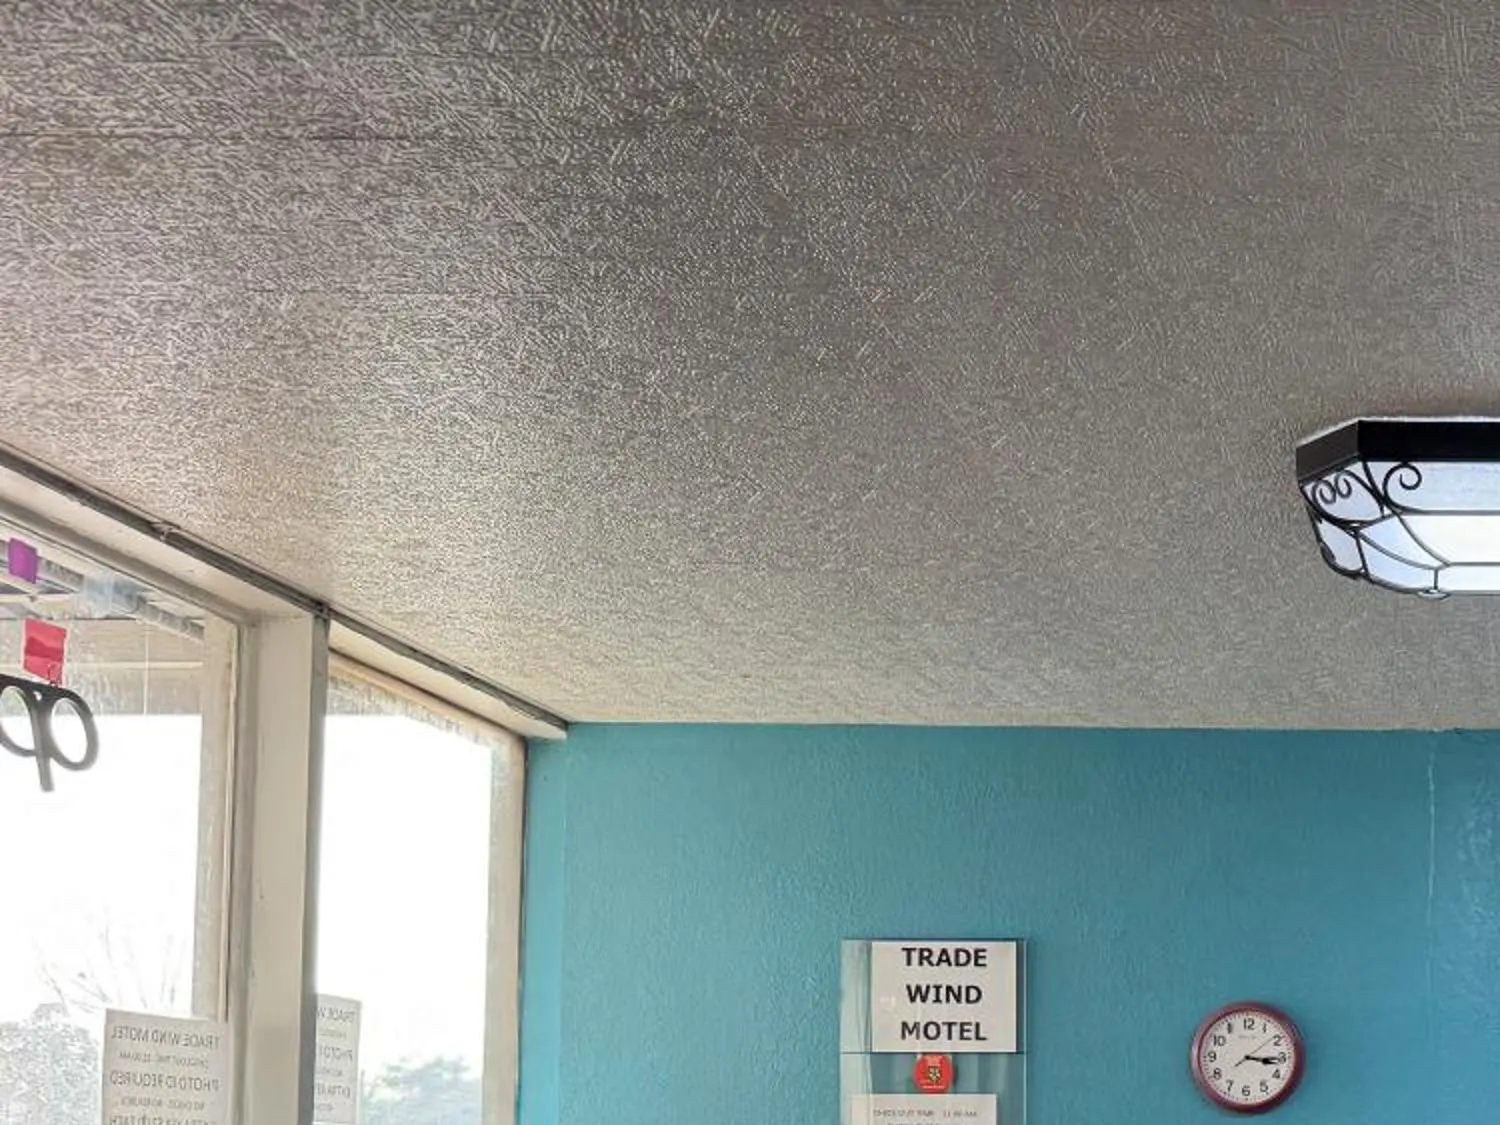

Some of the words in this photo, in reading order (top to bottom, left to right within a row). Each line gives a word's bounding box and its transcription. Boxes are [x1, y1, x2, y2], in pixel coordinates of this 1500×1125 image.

[901, 947, 988, 967] TRADE
[905, 985, 983, 1004] WIND
[1243, 1018, 1255, 1030] 12
[900, 1021, 987, 1041] MOTEL
[1213, 1034, 1226, 1046] 10
[1273, 1034, 1282, 1046] 2
[1208, 1051, 1217, 1062] 9
[1278, 1051, 1287, 1064] 3
[1213, 1068, 1222, 1080] 8
[1272, 1069, 1281, 1080] 4
[1226, 1080, 1234, 1092] 7
[1242, 1086, 1251, 1097] 6
[1259, 1080, 1269, 1093] 5
